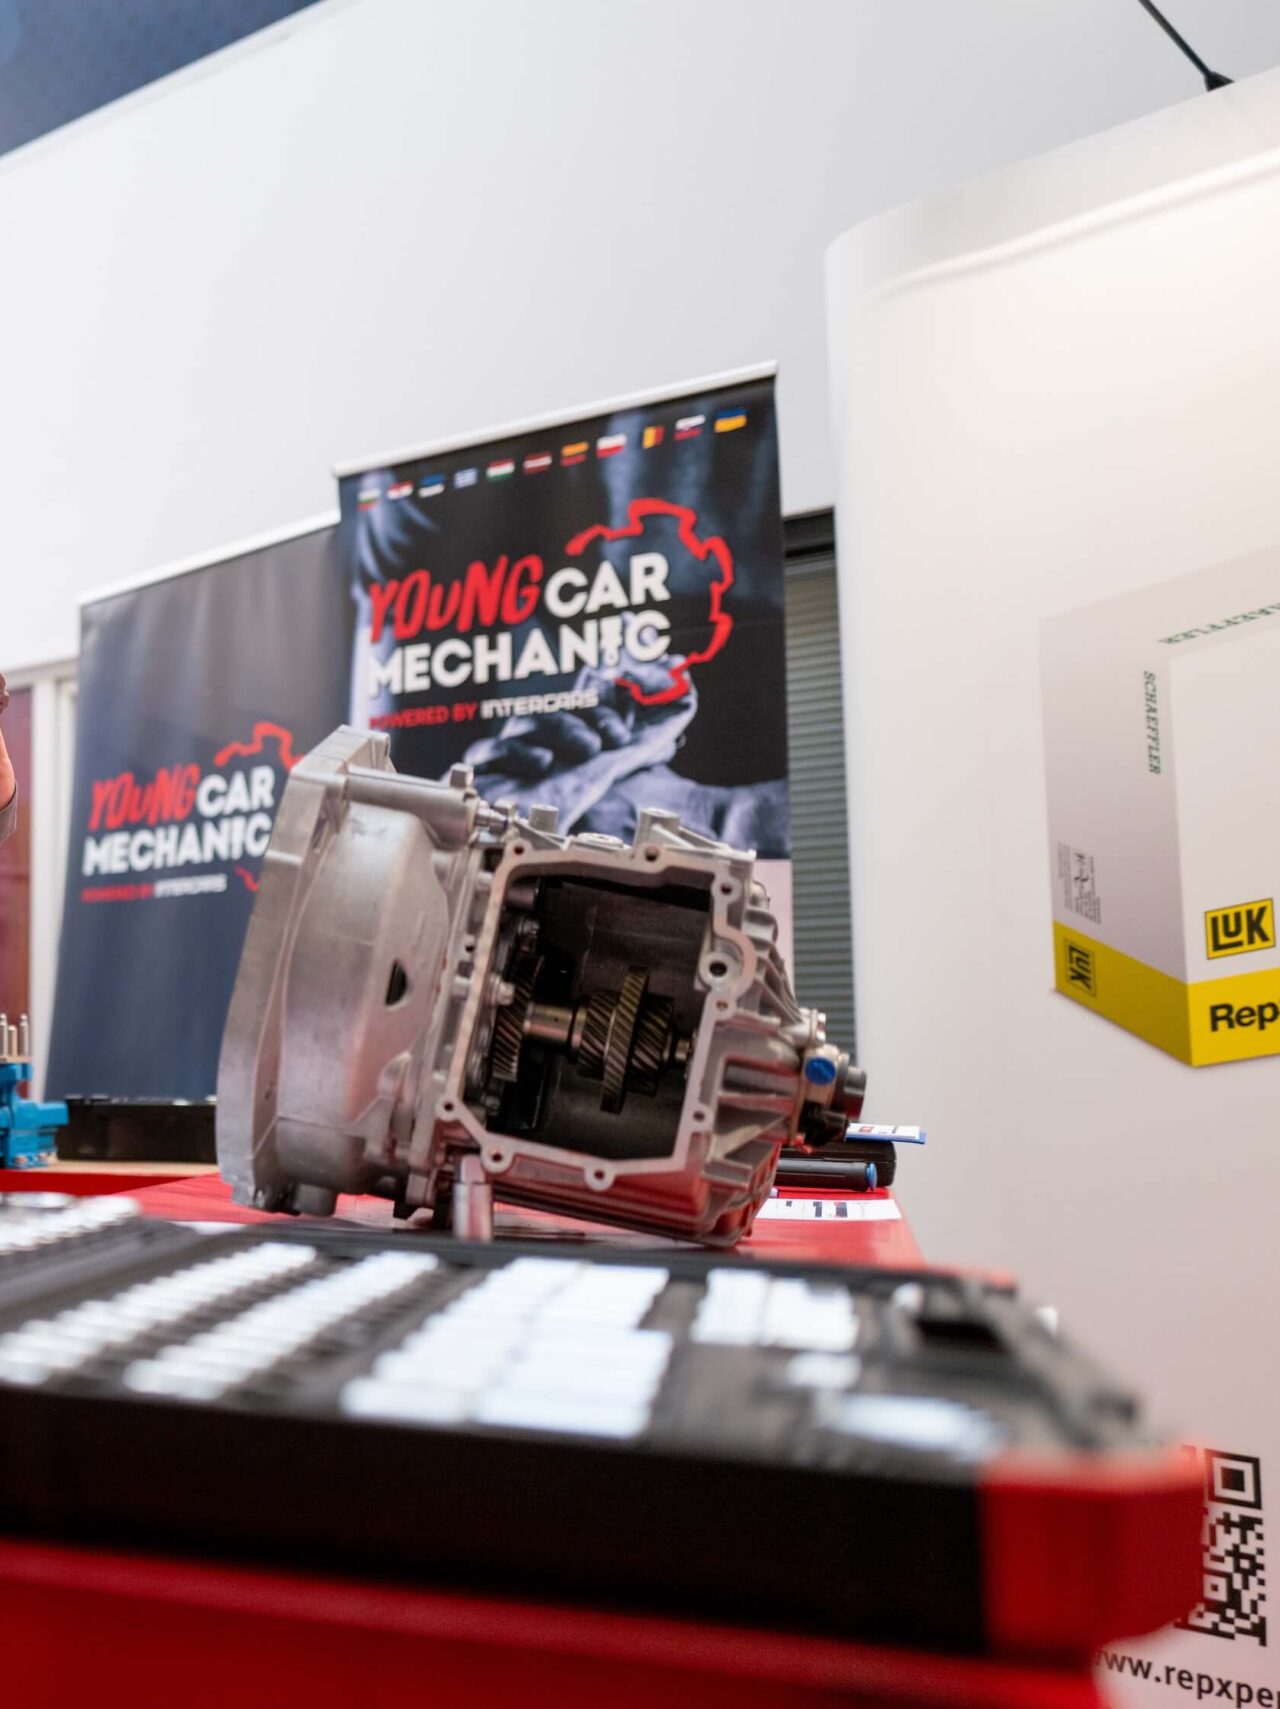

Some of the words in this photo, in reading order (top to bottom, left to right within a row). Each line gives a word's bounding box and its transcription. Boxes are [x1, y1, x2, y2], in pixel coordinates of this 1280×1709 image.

[544, 551, 671, 619] CAR
[368, 610, 672, 696] MECHANIC
[369, 706, 449, 730] POWERED
[452, 702, 479, 721] BY
[1144, 670, 1161, 775] SCHAEFFLER
[196, 765, 276, 818] CAR
[82, 812, 272, 877] MECHANIC
[1209, 1001, 1280, 1032] Rep
[1095, 1650, 1280, 1709] ww.repxpe
